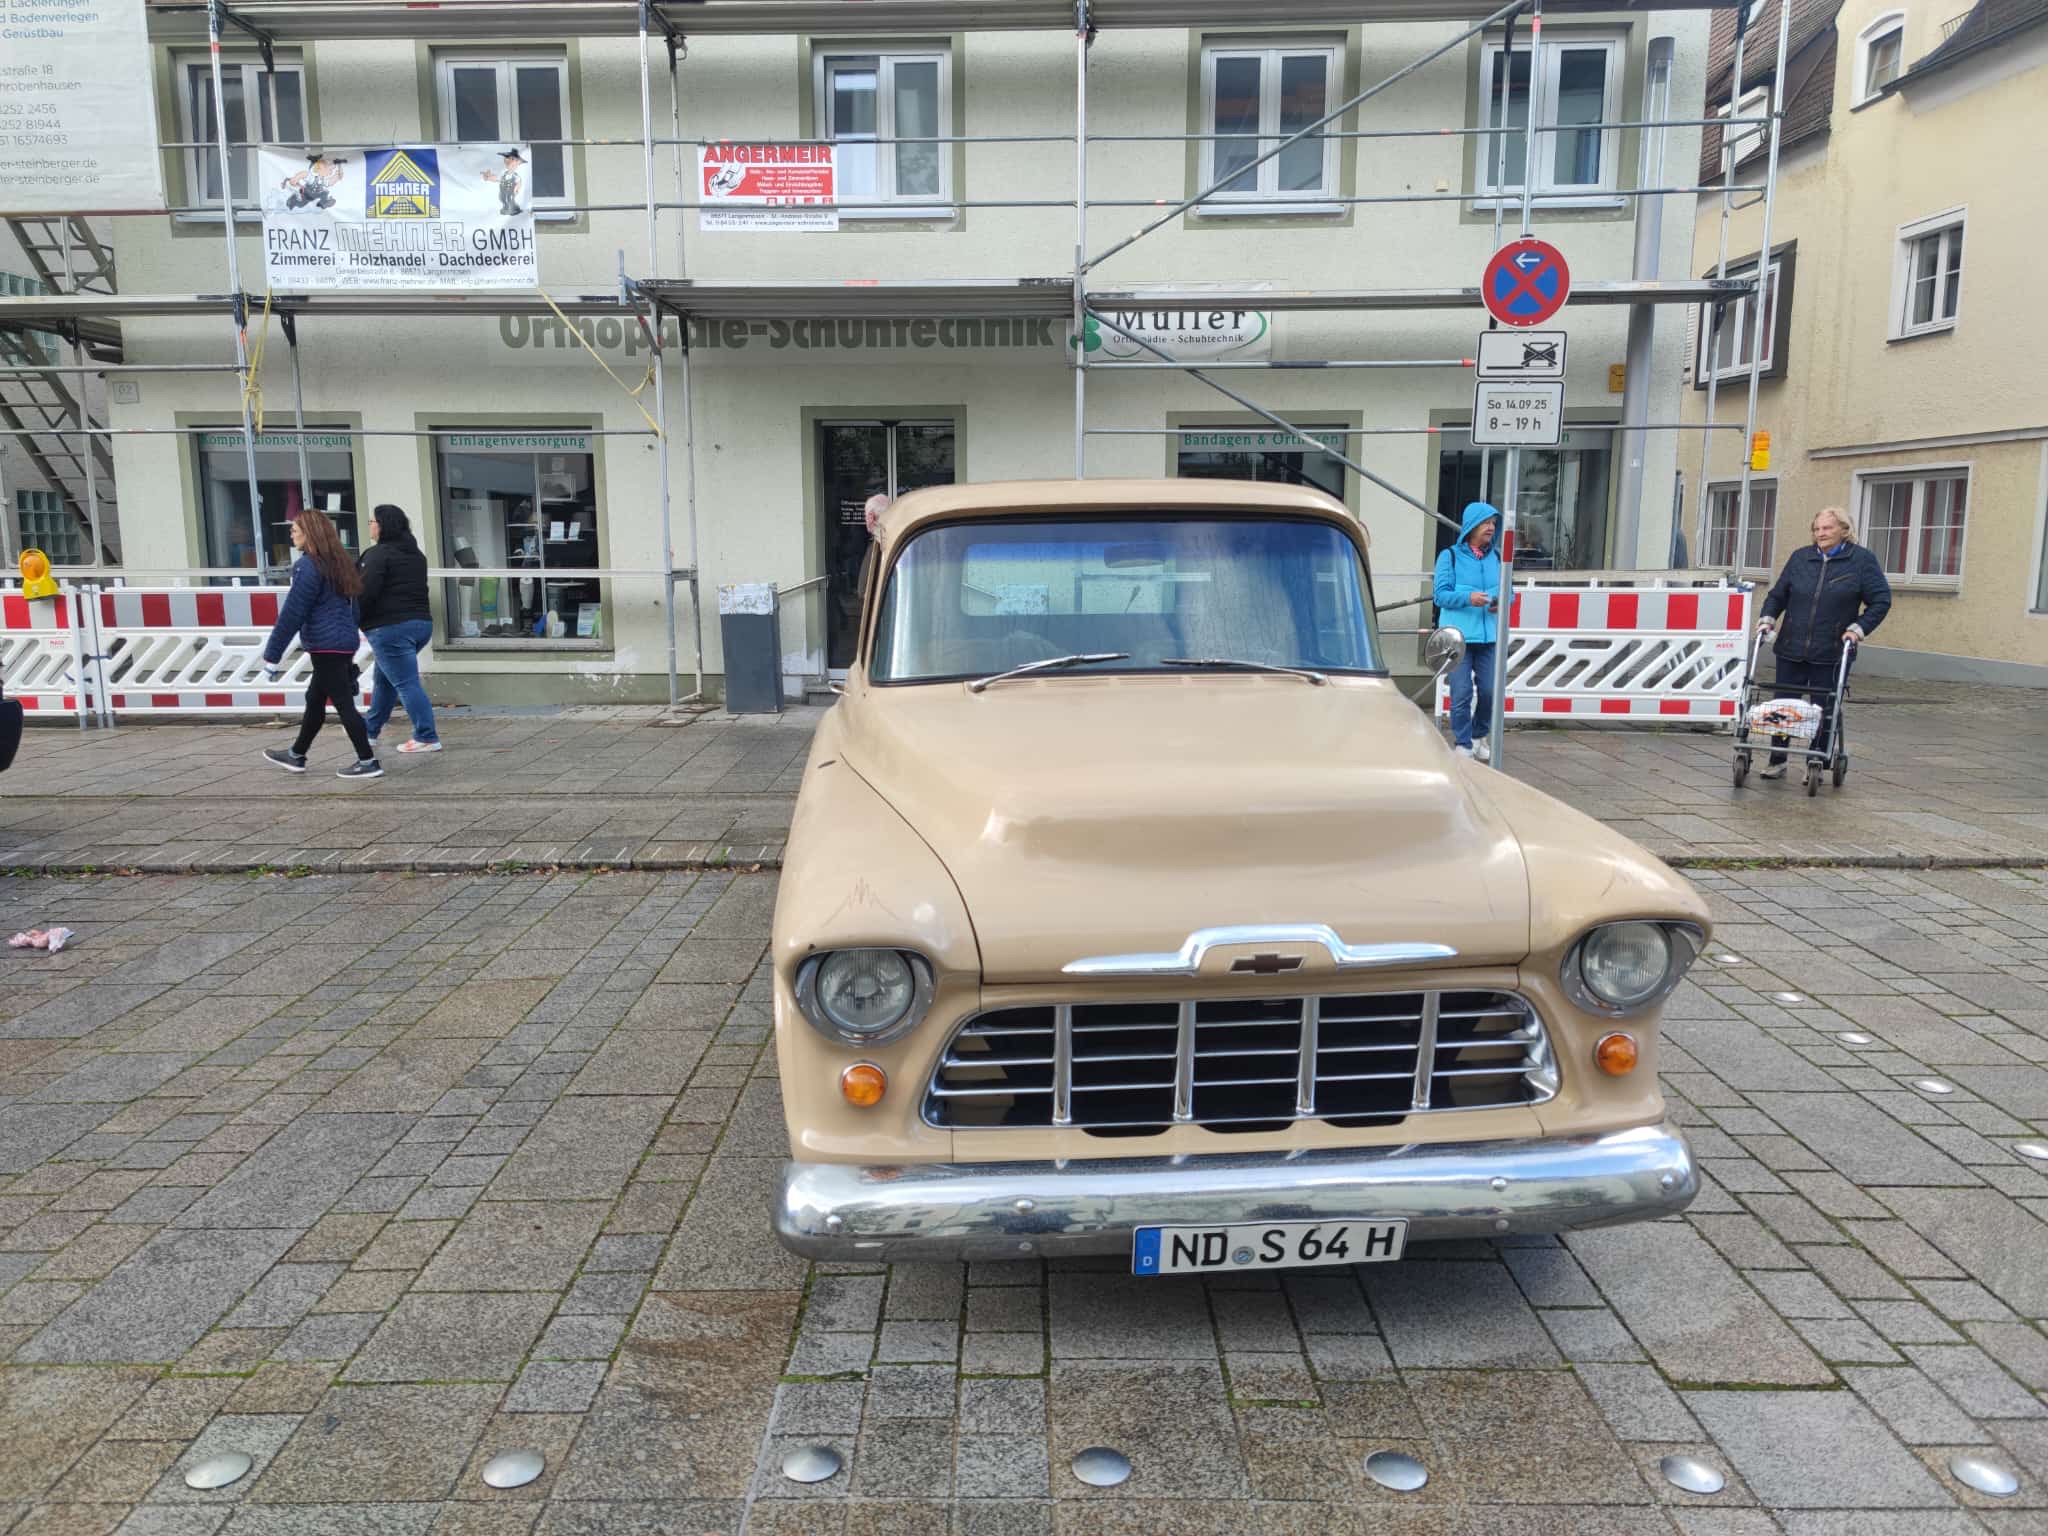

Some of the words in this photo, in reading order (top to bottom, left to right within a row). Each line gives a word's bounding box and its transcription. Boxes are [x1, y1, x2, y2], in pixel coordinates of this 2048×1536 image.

[704, 144, 833, 163] ANGERMEIR
[375, 183, 431, 196] MEHNER
[268, 228, 329, 251] FRANZ
[334, 221, 465, 252] MEHNER
[471, 228, 534, 251] GMBH
[270, 252, 336, 266] Zimmerei
[349, 252, 427, 267] Holzhandel
[438, 252, 535, 267] Dachdeckerei
[500, 317, 1054, 357] Orthopdie-Schuhtechnik
[1177, 334, 1244, 345] Schuhtechnik
[1505, 399, 1548, 410] 14.09.25
[1489, 417, 1499, 430] 8
[1515, 417, 1529, 430] 19
[1532, 417, 1541, 430] h
[449, 434, 586, 449] Einlagenversorgung
[1184, 433, 1252, 447] Bandagen
[1257, 433, 1265, 445] &
[1272, 433, 1339, 446] Orthsen
[1143, 1256, 1153, 1267] D
[1171, 1232, 1229, 1268] ND
[1259, 1229, 1287, 1263] S
[1298, 1226, 1350, 1261] 64
[1365, 1226, 1397, 1257] H
